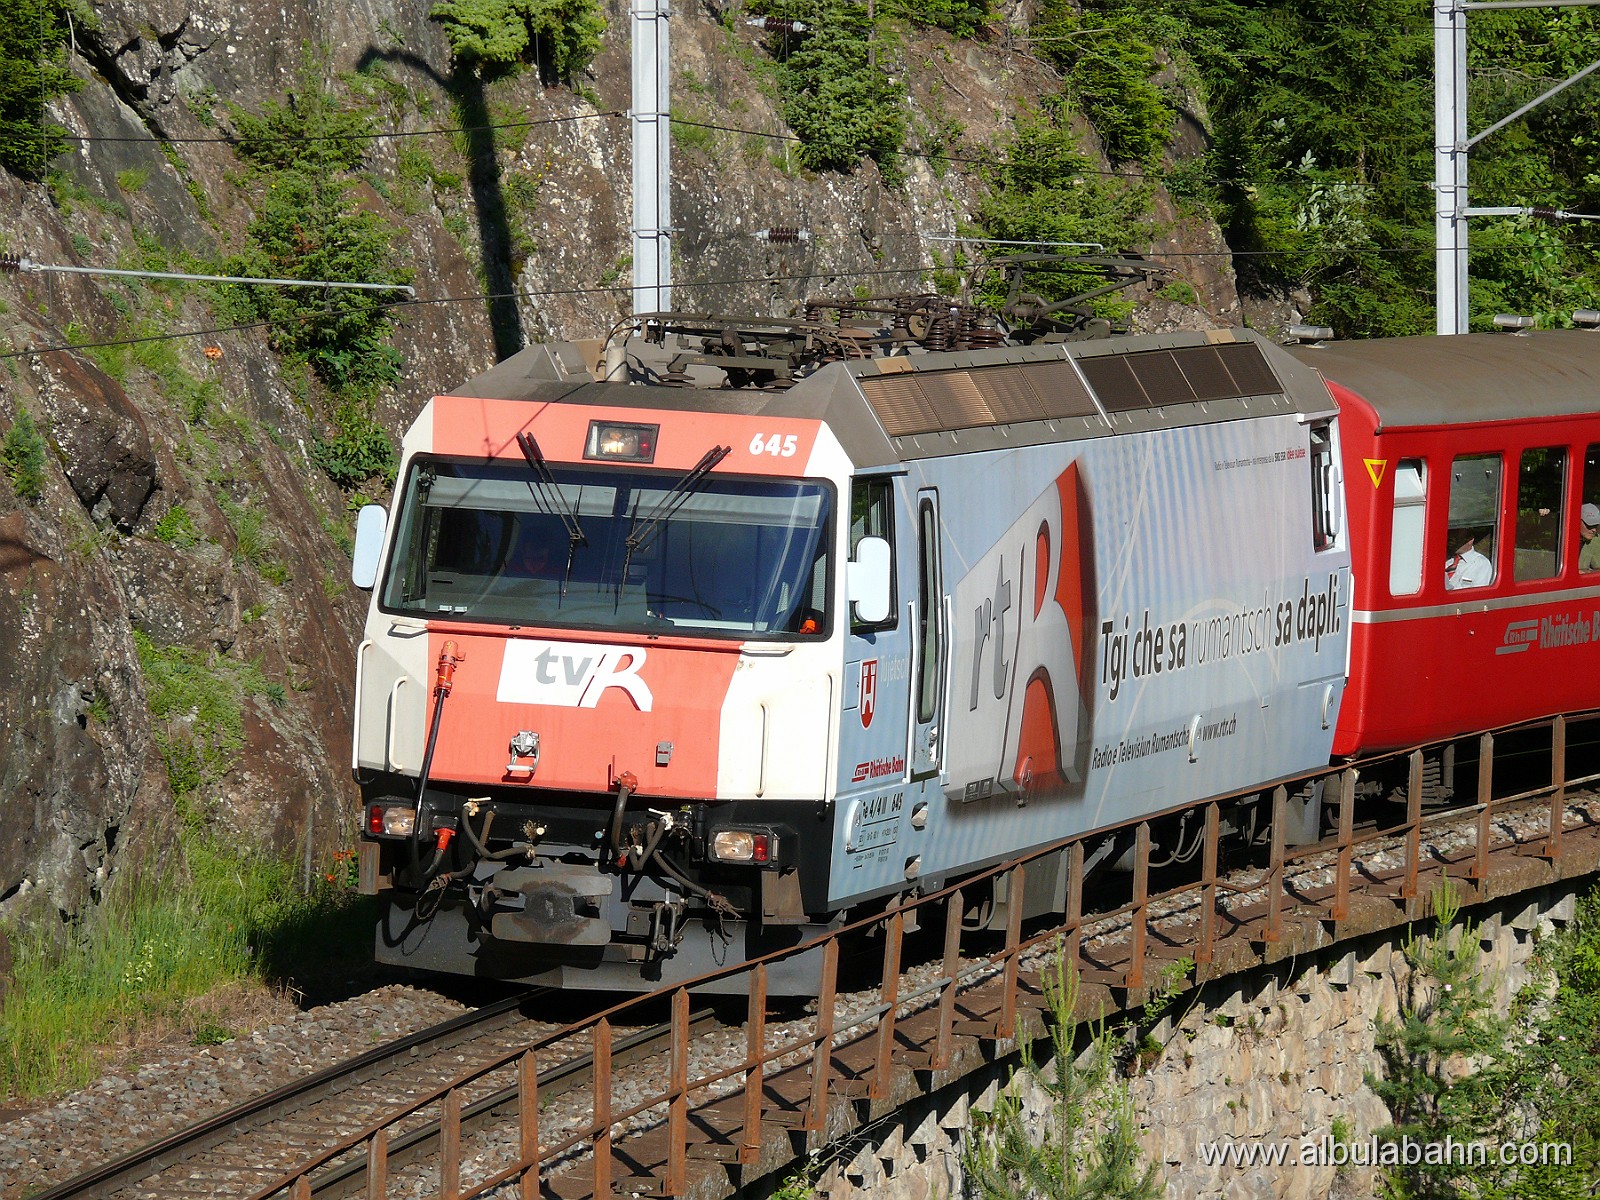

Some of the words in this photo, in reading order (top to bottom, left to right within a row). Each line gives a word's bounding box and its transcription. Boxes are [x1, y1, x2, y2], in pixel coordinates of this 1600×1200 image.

[749, 433, 797, 457] 645
[1101, 613, 1130, 700] Tgi
[1132, 609, 1164, 678] che
[1168, 621, 1187, 671] sa
[1190, 586, 1272, 667] rumantsch
[1274, 600, 1293, 647] sa
[1297, 573, 1341, 653] dapli.
[1540, 611, 1591, 649] Rhätische
[1592, 609, 1600, 642] B
[1092, 744, 1113, 770] Radio
[1117, 737, 1151, 763] Televisiun
[1202, 713, 1237, 741] www.rtr.ch
[892, 792, 903, 812] 645
